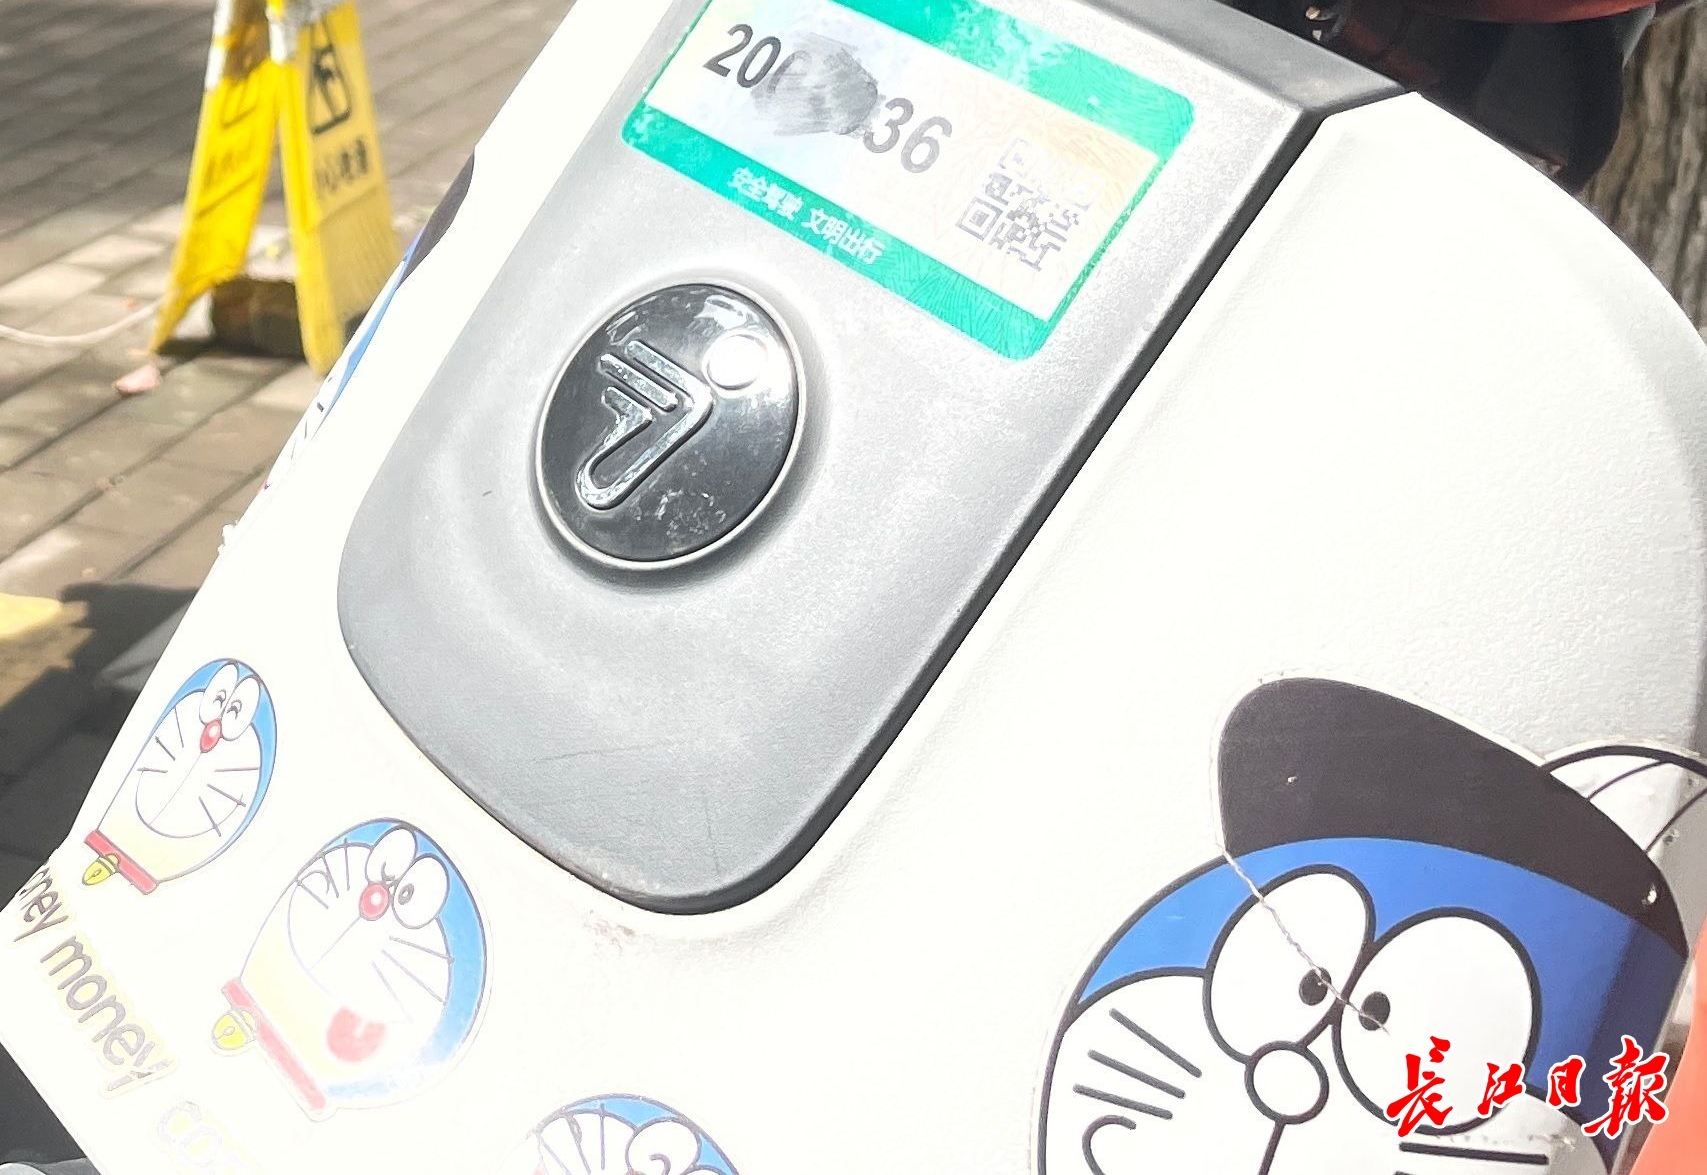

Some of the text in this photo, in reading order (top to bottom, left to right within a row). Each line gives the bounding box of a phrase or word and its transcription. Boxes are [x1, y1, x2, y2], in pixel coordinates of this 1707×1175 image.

[703, 24, 952, 173] 2036
[801, 207, 886, 265] 文明出行
[40, 935, 173, 1092] money
